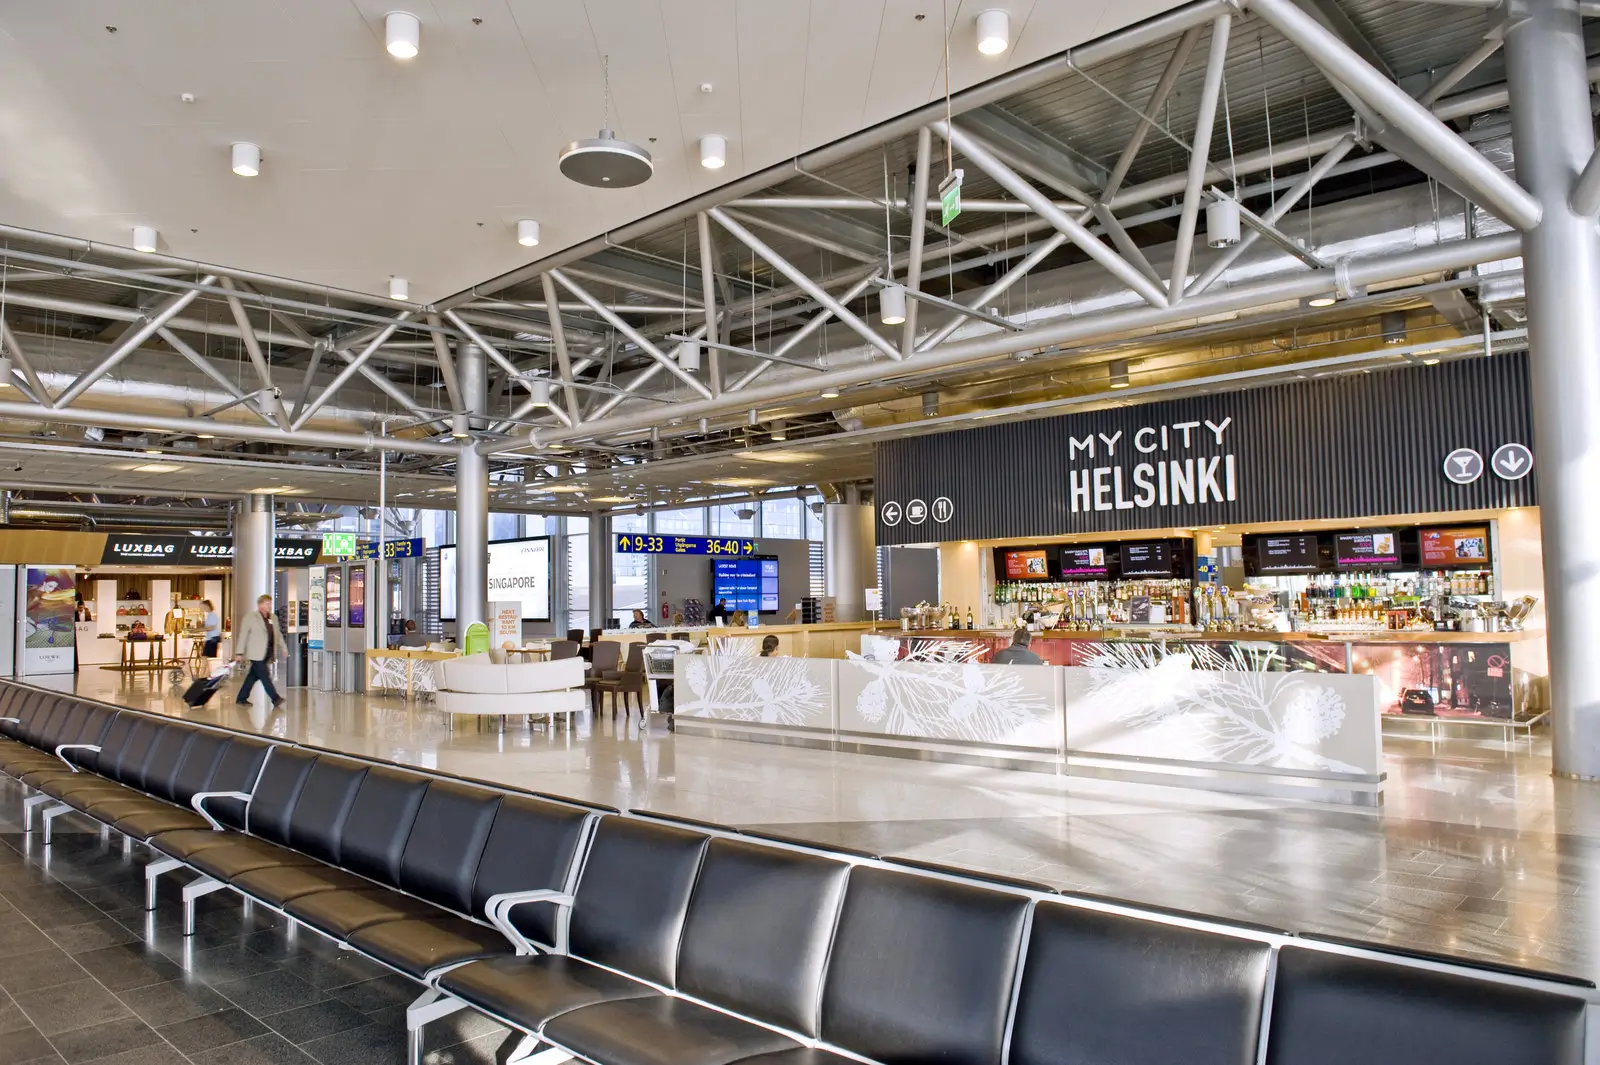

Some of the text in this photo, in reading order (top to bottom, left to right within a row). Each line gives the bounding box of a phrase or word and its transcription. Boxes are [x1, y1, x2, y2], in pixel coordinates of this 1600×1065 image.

[1069, 416, 1232, 461] MY CITY
[1070, 454, 1236, 513] HELSINKI
[113, 543, 175, 553] LUXBAG
[190, 545, 235, 554] LUXBA
[406, 541, 412, 556] 3
[635, 536, 663, 553] 9-33
[706, 539, 739, 555] 36-40
[488, 576, 535, 590] SINGAPORE
